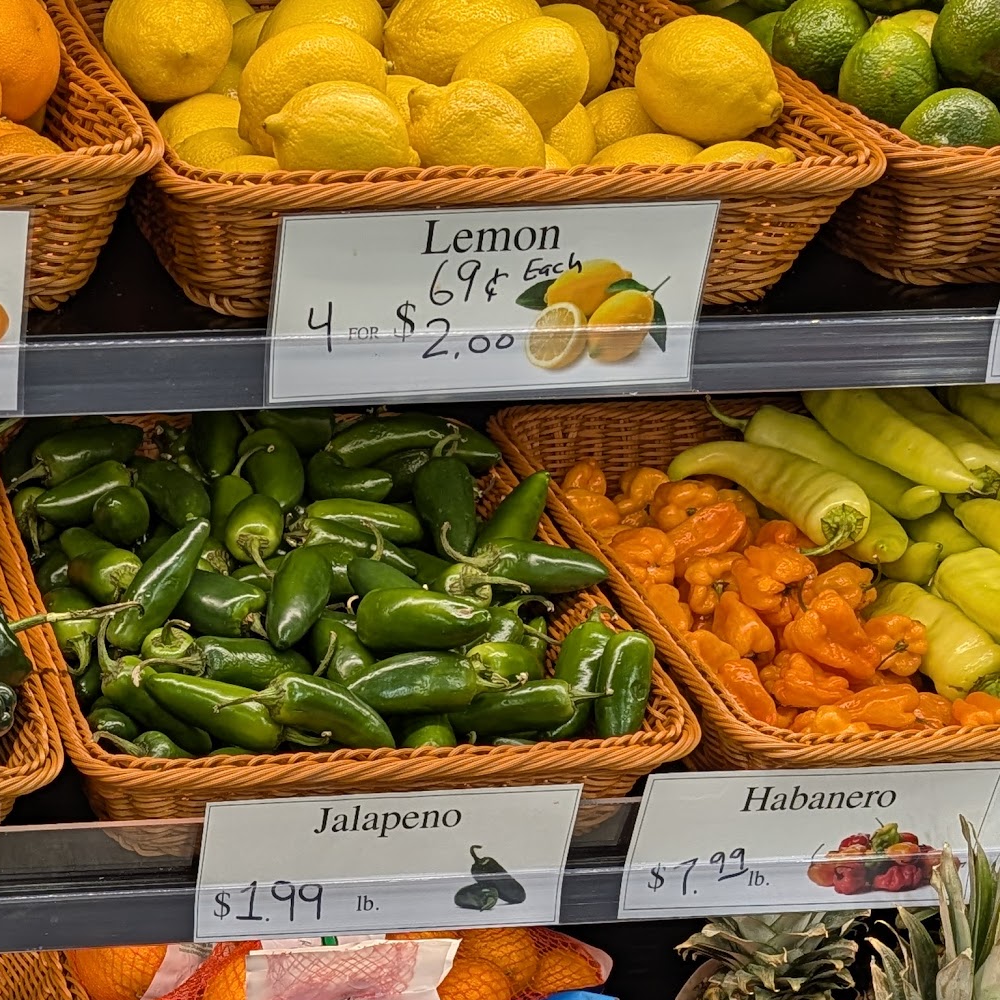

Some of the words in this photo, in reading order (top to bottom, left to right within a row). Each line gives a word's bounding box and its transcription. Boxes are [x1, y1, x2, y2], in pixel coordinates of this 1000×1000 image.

[421, 219, 561, 255] Lemon
[523, 252, 583, 281] Each
[308, 301, 332, 352] 4
[348, 326, 379, 341] FOR
[740, 785, 897, 812] Habanero
[314, 804, 463, 838] Jalapeno
[748, 870, 770, 887] lb.
[213, 880, 324, 922] $1.99
[356, 895, 380, 912] lb.
